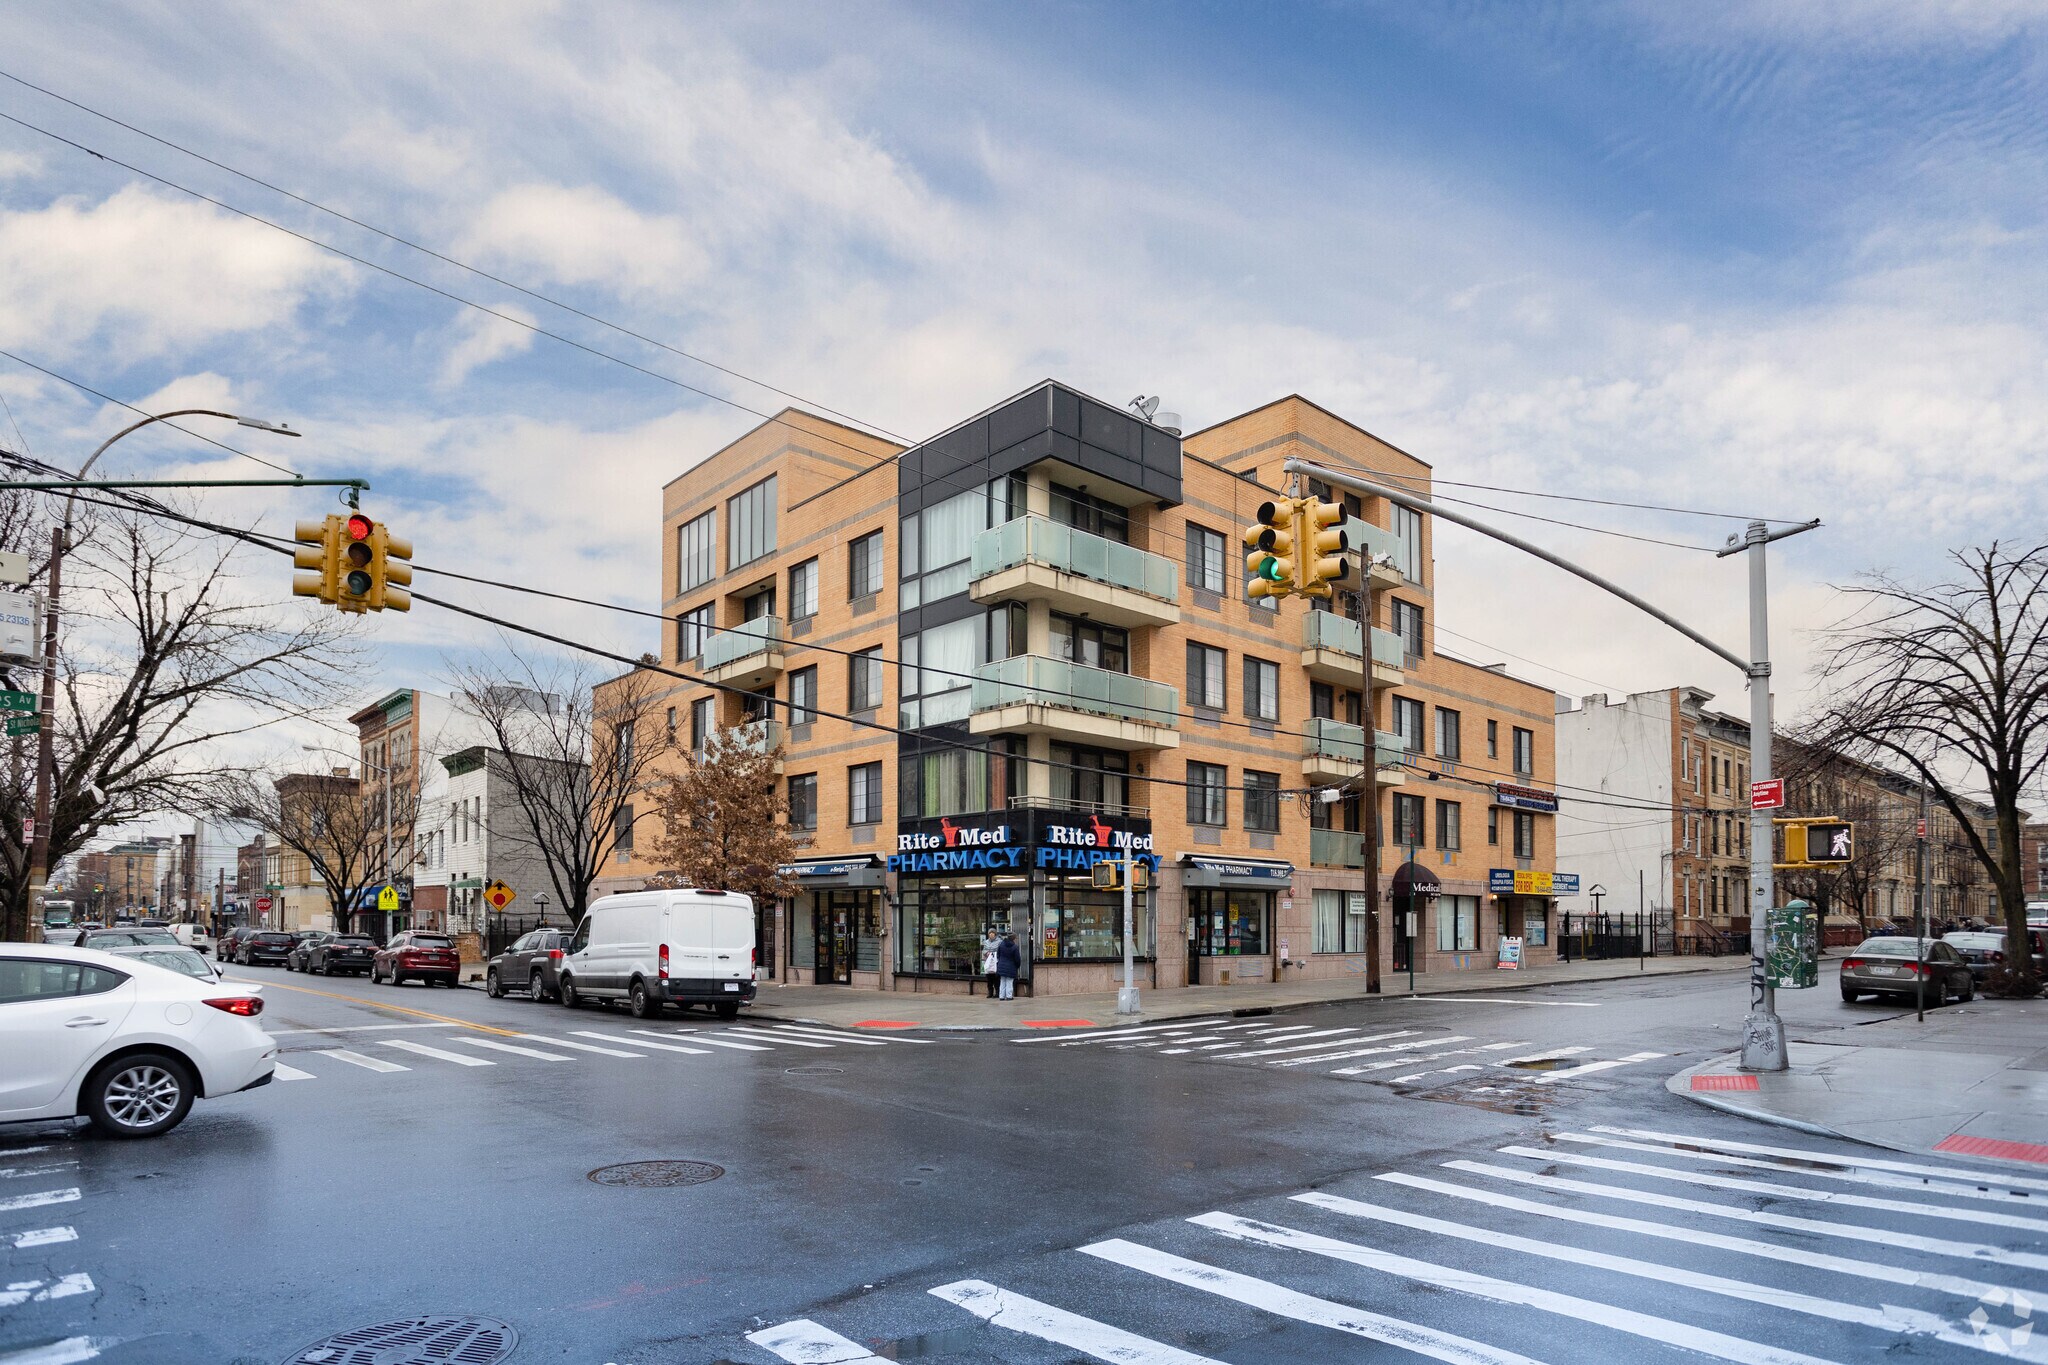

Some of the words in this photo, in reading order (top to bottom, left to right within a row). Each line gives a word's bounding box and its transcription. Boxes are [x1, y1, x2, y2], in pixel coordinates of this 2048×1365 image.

[19, 695, 31, 705] Av
[898, 833, 940, 851] Rite
[958, 825, 1008, 846] Med
[1050, 825, 1096, 846] Rite
[1114, 831, 1154, 850] Med
[887, 847, 1022, 873] PHARMACY
[1226, 866, 1253, 876] PHARMACY
[1523, 880, 1533, 892] RENT
